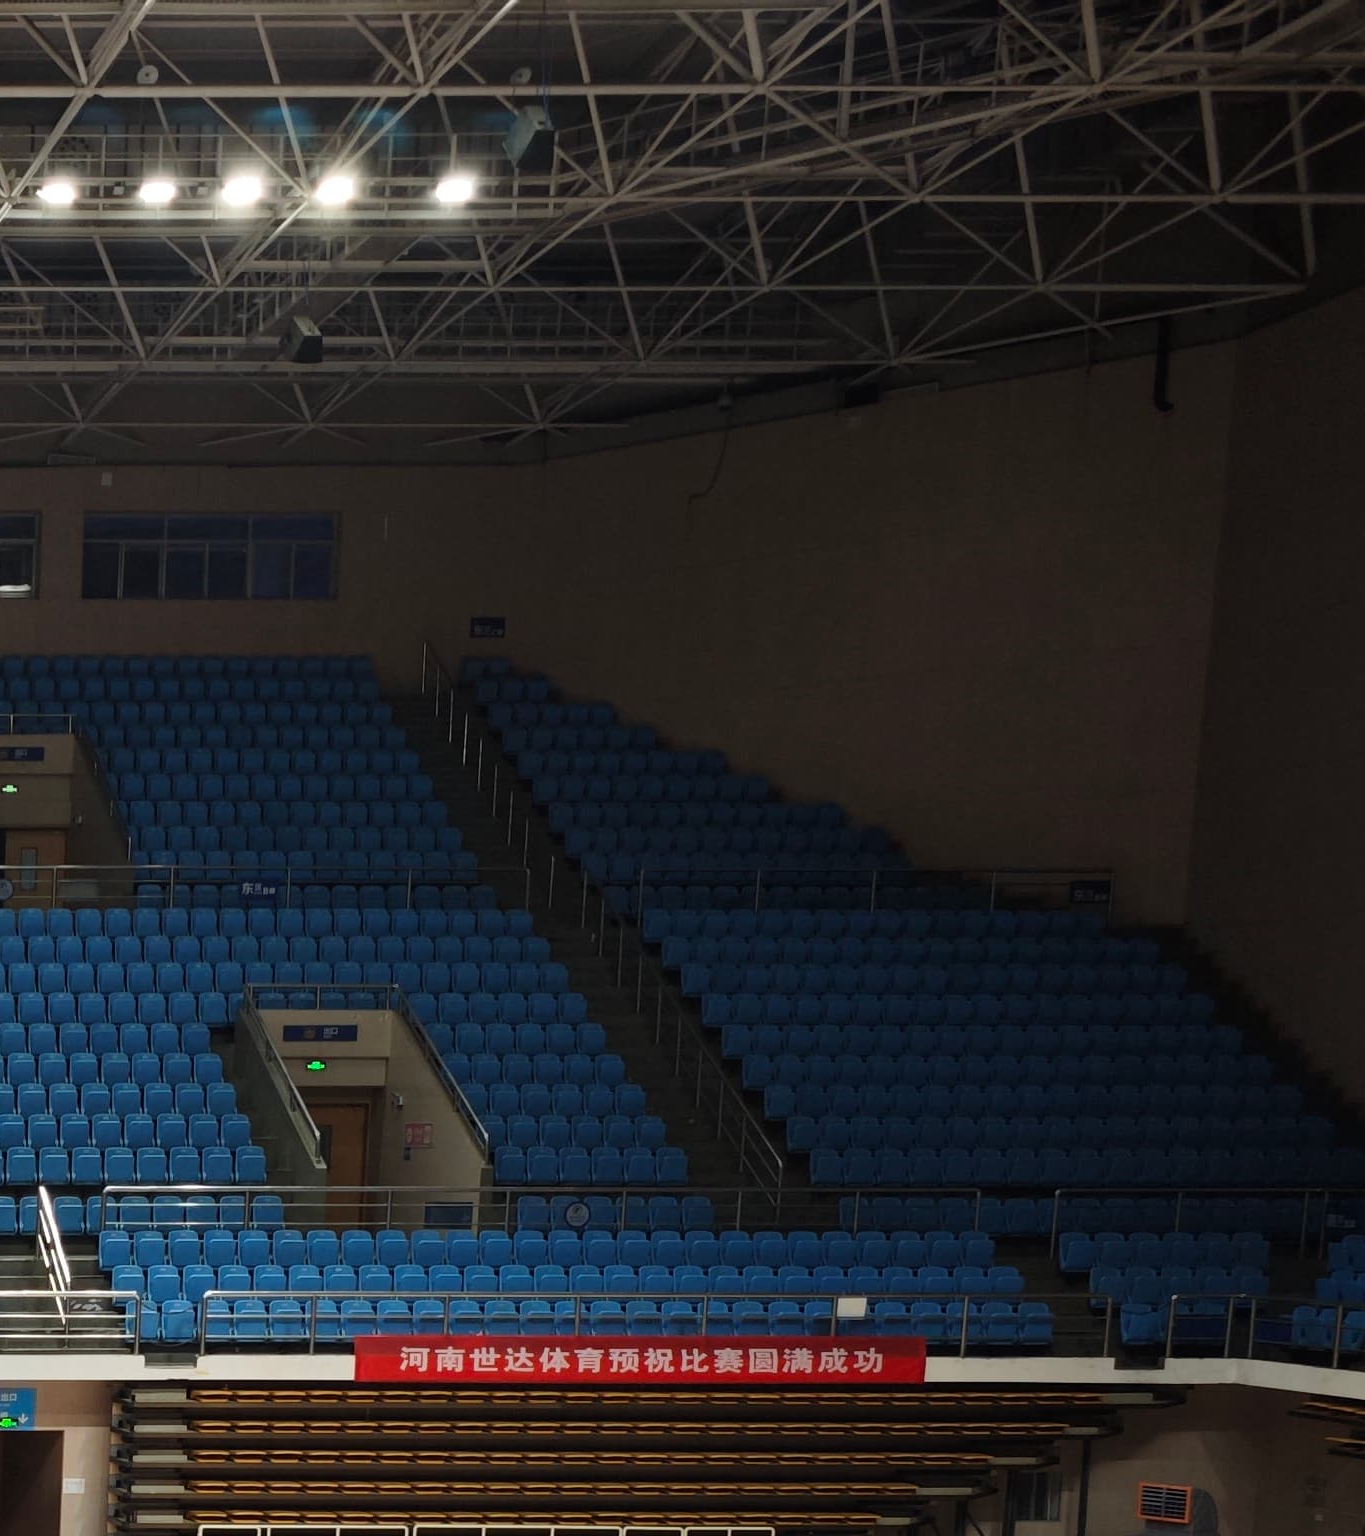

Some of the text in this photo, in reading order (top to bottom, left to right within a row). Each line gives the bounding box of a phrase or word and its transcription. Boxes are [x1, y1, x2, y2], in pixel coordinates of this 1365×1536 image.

[400, 1346, 882, 1373] 河南世达体育预祝比赛圆满成功
